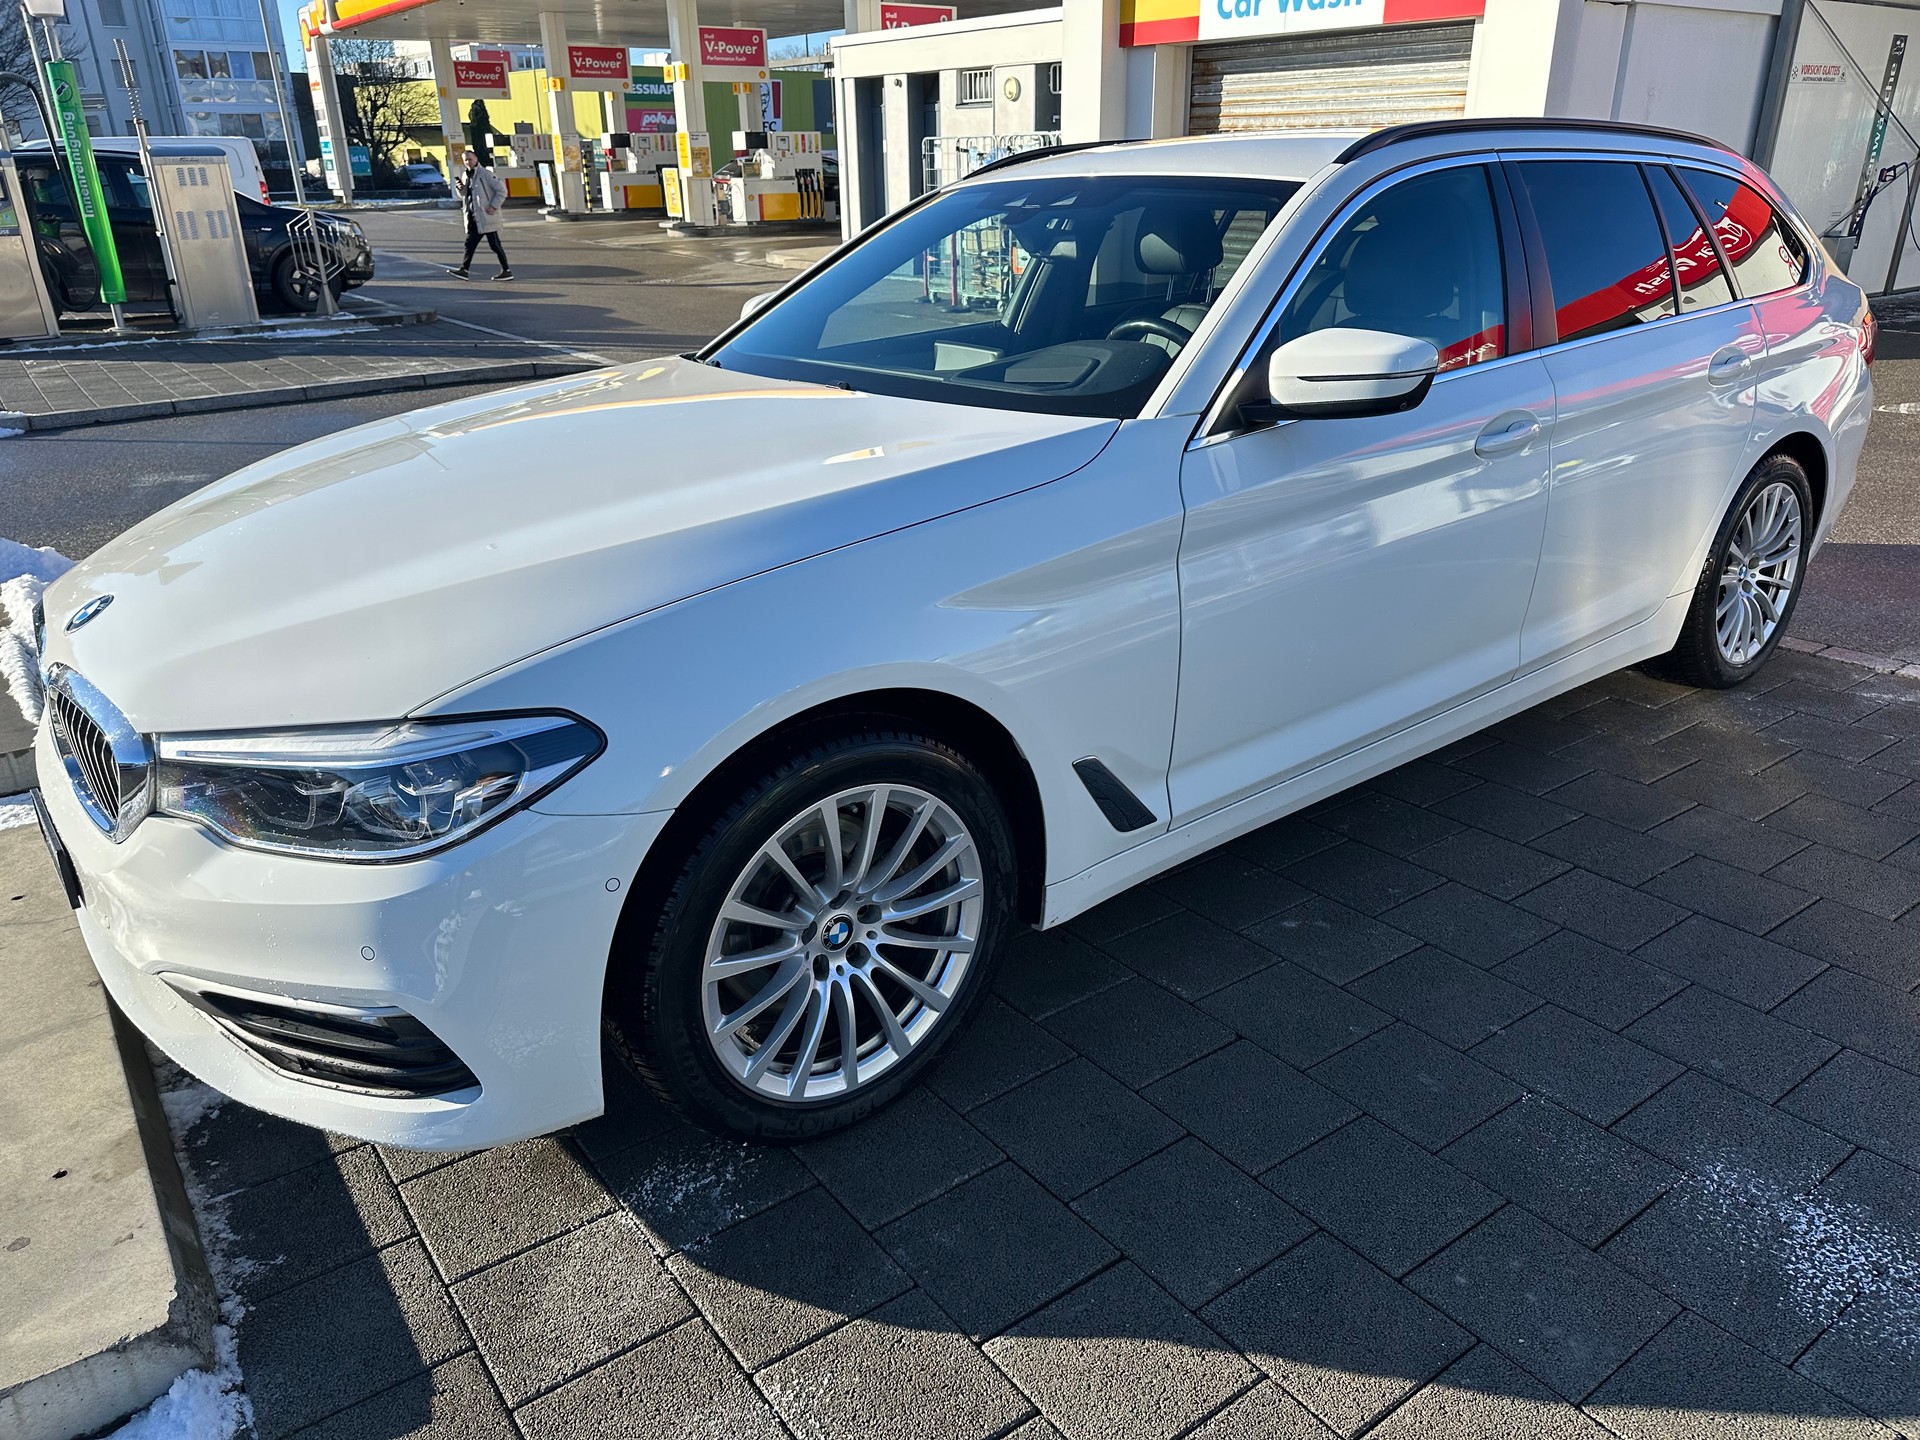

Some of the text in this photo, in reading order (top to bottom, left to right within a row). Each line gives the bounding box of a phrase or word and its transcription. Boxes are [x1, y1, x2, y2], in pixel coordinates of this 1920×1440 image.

[704, 41, 758, 54] V-Power
[573, 57, 621, 68] V-Power
[458, 71, 500, 80] V-Power
[762, 121, 777, 132] FC
[63, 111, 95, 218] Innenreinigung
